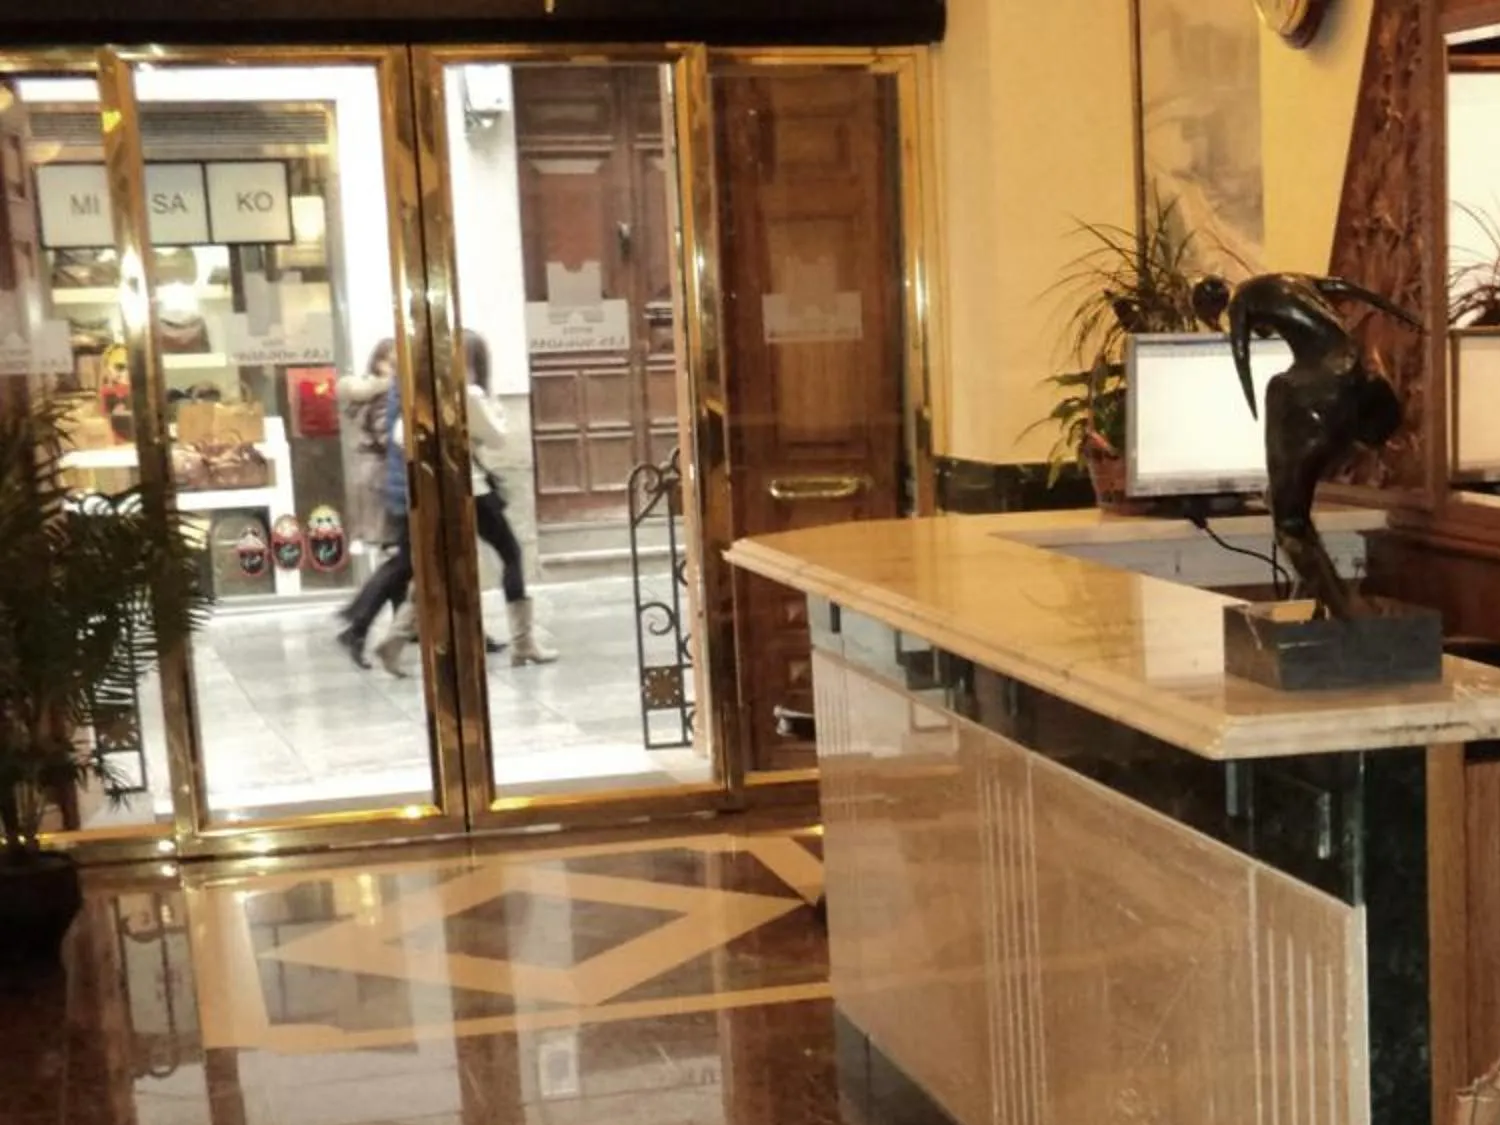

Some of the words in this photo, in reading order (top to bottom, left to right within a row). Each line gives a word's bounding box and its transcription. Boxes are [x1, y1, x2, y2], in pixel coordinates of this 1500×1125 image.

[70, 193, 100, 215] MI
[149, 191, 191, 214] SA
[235, 190, 274, 213] KO
